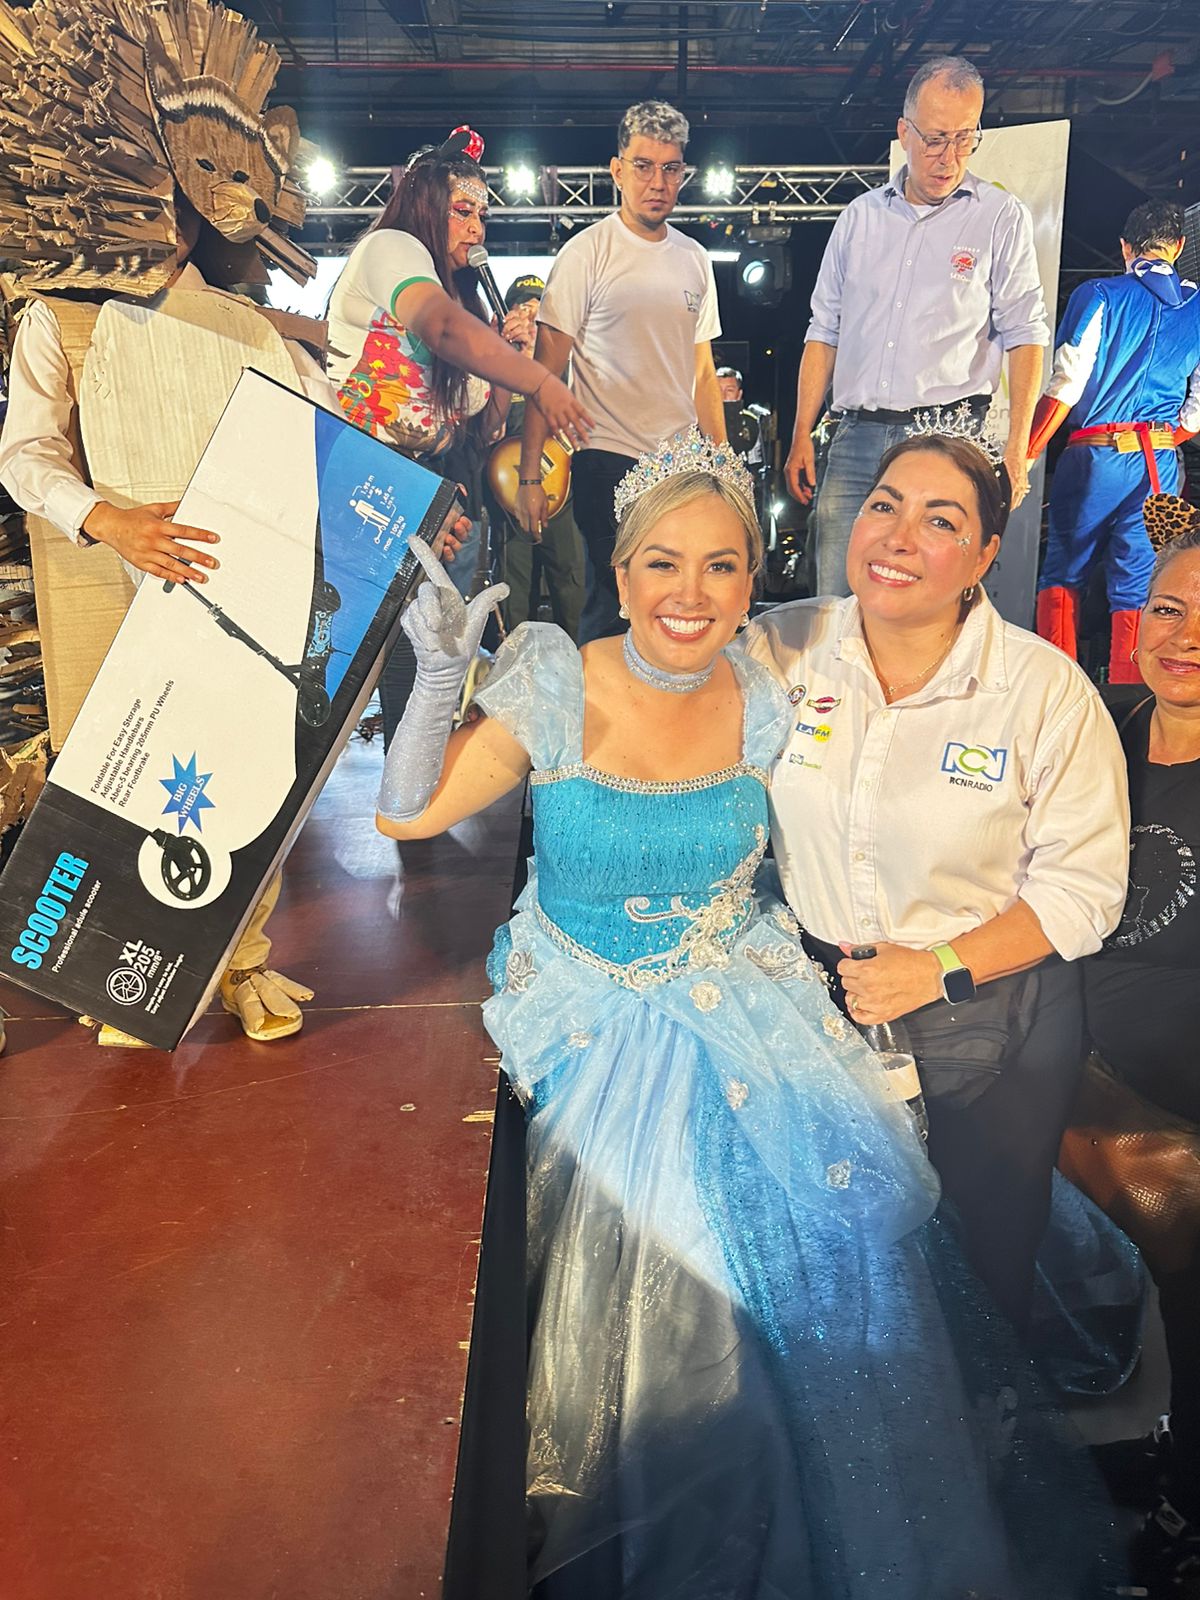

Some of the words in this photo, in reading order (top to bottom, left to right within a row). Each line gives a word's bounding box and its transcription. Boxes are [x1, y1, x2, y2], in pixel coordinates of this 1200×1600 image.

[390, 523, 399, 535] 100
[396, 515, 404, 524] kg
[90, 762, 110, 793] Foldable
[106, 747, 117, 761] For
[113, 728, 127, 747] Easy
[122, 699, 141, 727] Storage
[100, 759, 123, 798] Adjustable
[119, 717, 144, 758] Handlebars
[110, 776, 126, 803] Abec-5
[122, 748, 142, 776] bearing
[136, 721, 154, 747] 205mm
[149, 707, 160, 720] PU
[156, 680, 174, 707] Wheels
[118, 789, 131, 807] Rear
[127, 752, 150, 789] Footbrake
[173, 783, 187, 802] BIG
[178, 775, 204, 817] WHEELS
[11, 852, 89, 969] SCOOTER
[51, 928, 78, 973] Professional
[84, 880, 101, 908] scooter
[118, 940, 143, 966] XL
[133, 945, 155, 974] 205
[147, 950, 162, 978] mm/8"
